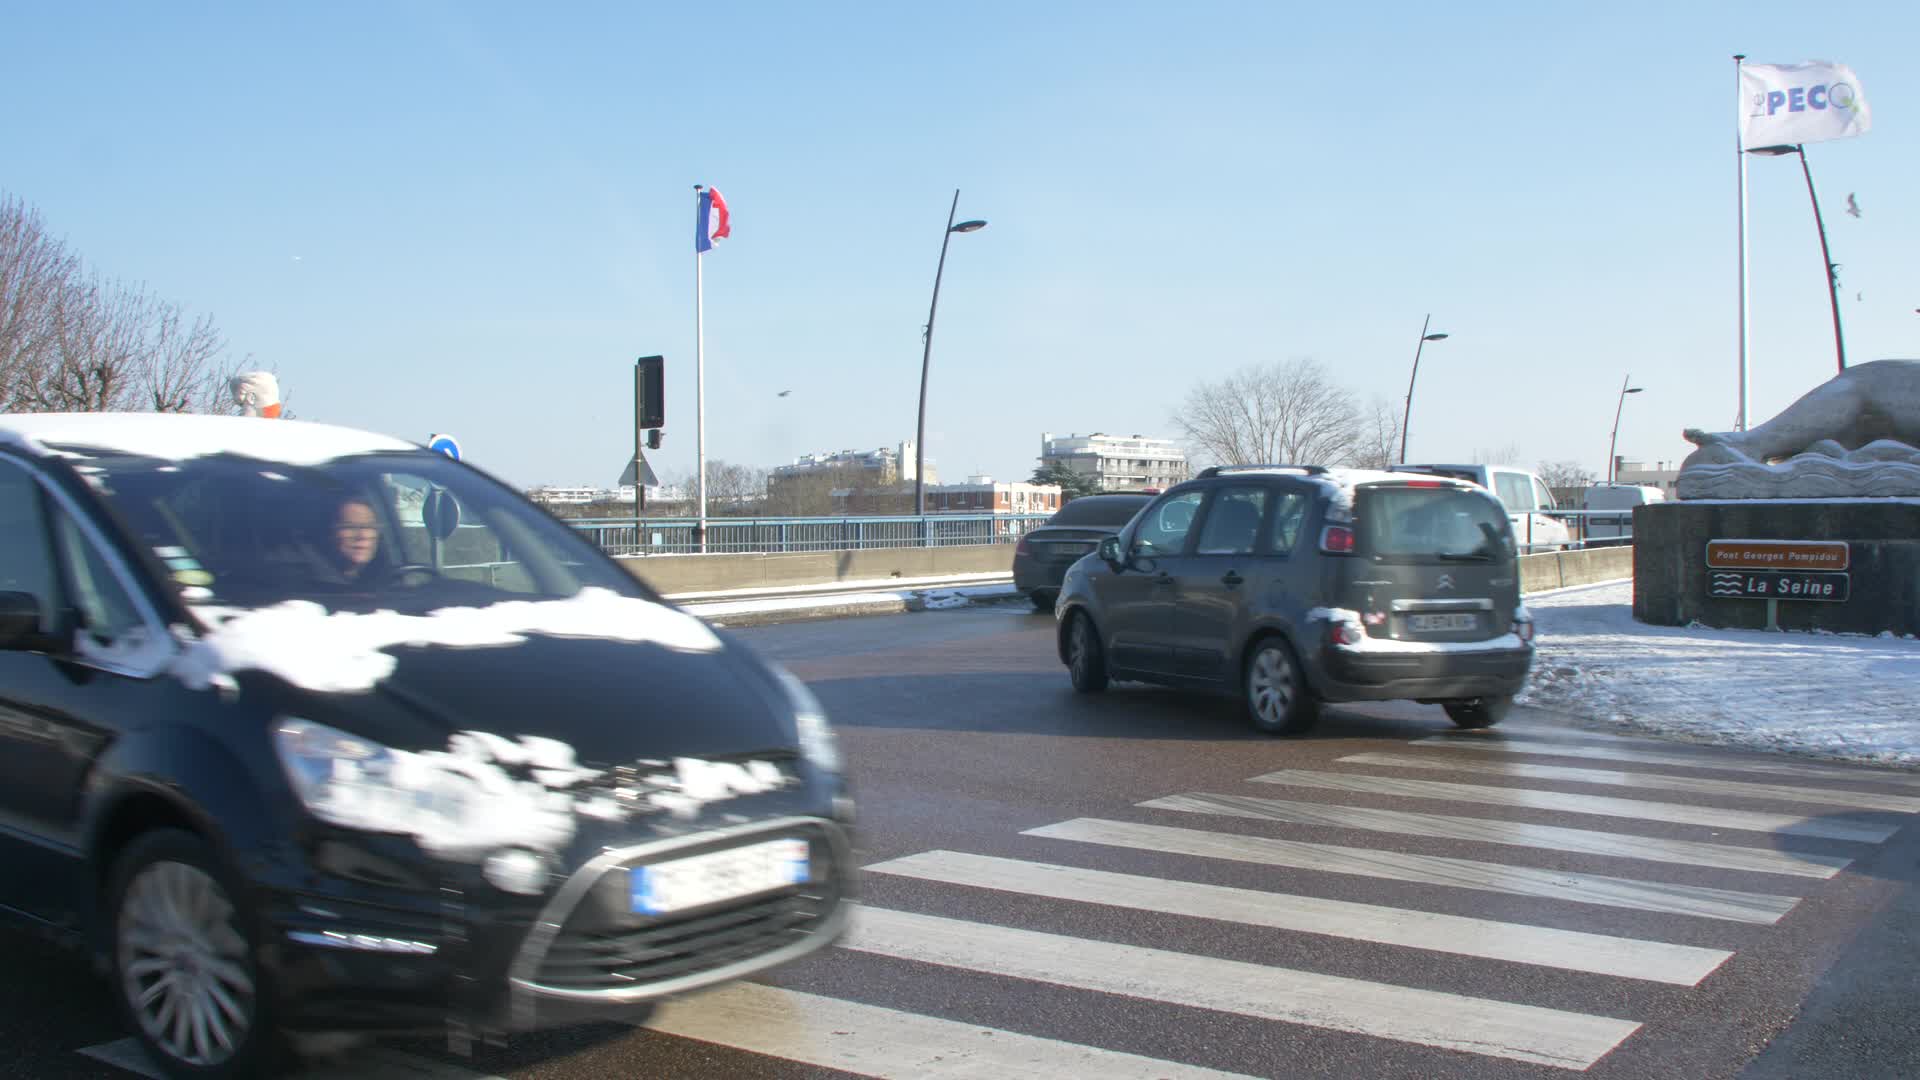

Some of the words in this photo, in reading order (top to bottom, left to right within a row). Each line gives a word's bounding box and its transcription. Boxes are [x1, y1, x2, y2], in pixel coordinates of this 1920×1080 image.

[1716, 551, 1739, 560] Pont
[1743, 551, 1785, 562] Georges
[1788, 551, 1839, 563] Pompidou
[1747, 577, 1768, 593] La
[1777, 578, 1834, 595] Seine
